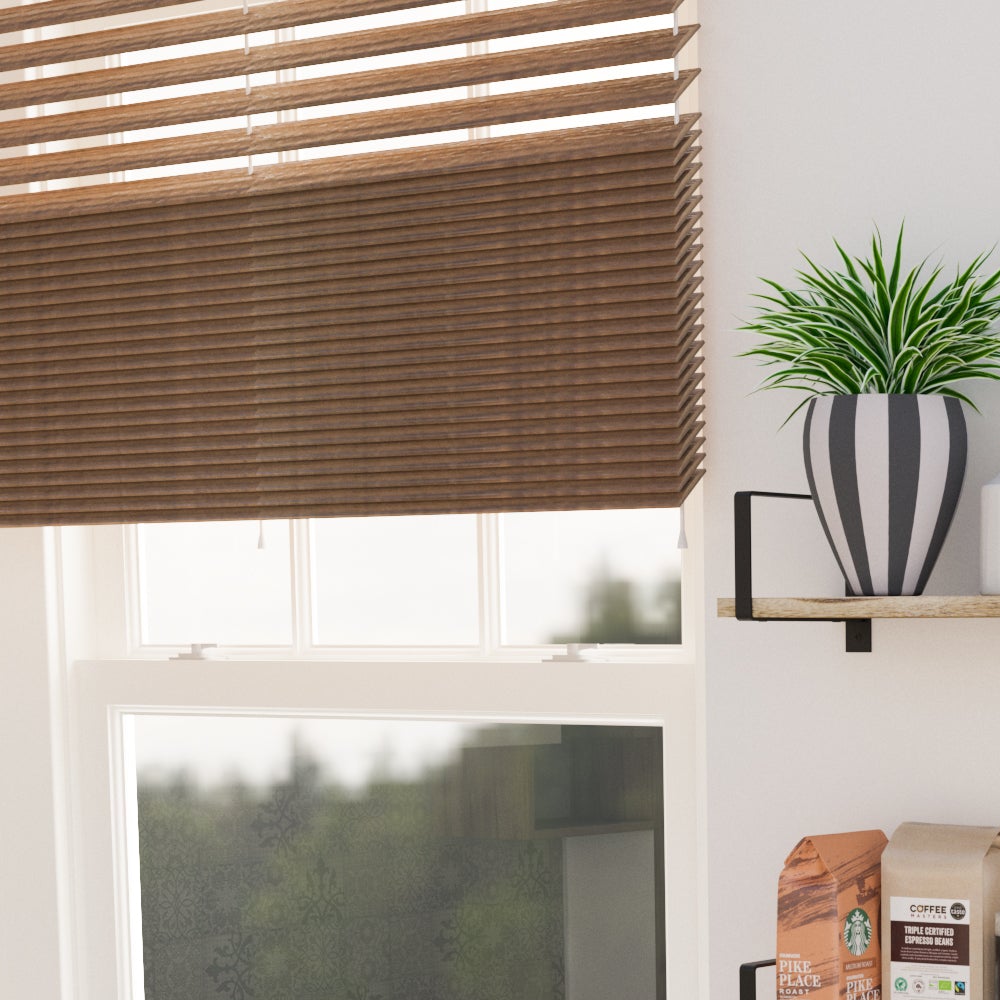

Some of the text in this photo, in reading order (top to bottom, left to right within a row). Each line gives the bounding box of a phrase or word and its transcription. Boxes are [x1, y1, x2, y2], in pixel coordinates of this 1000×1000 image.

[910, 904, 947, 914] COFFEE
[904, 926, 954, 937] TRIPLE CERTIFIED
[905, 936, 954, 947] ESPRESSO BEANS
[779, 960, 812, 974] PIKE
[779, 973, 822, 988] PLACE
[846, 978, 873, 994] PIKE
[779, 988, 810, 996] ROAST
